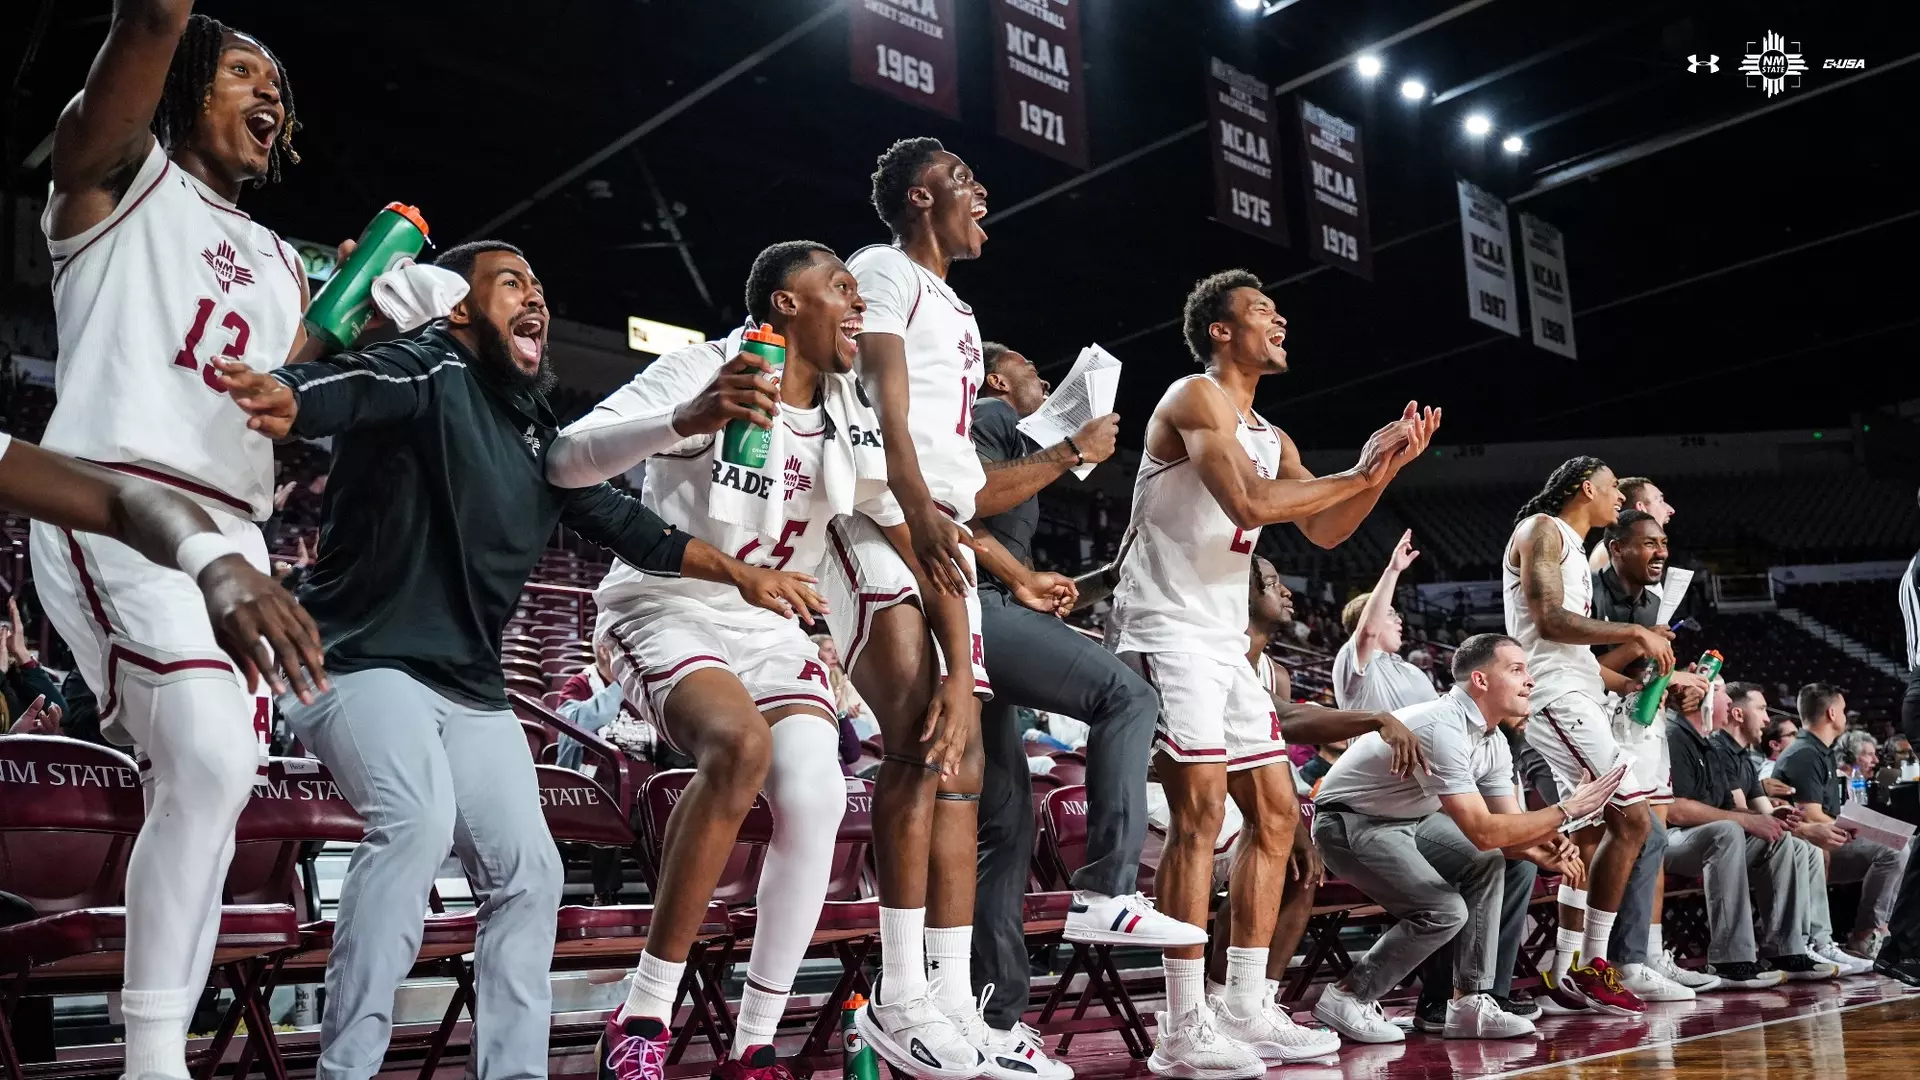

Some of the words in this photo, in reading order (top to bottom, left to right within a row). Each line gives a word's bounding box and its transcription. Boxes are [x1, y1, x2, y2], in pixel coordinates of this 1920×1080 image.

[1005, 22, 1070, 77] NCAA
[876, 44, 935, 95] 1969
[1019, 100, 1066, 146] 1971
[1220, 119, 1271, 165] NCAA
[1311, 160, 1358, 203] NCAA
[1231, 187, 1271, 227] 1975
[1322, 224, 1358, 262] 1979
[214, 266, 233, 280] STATE
[215, 258, 233, 274] NM
[174, 298, 250, 394] 13
[797, 659, 828, 690] A
[47, 763, 136, 788] STATE
[297, 781, 344, 801] STA
[540, 788, 600, 807] STATE
